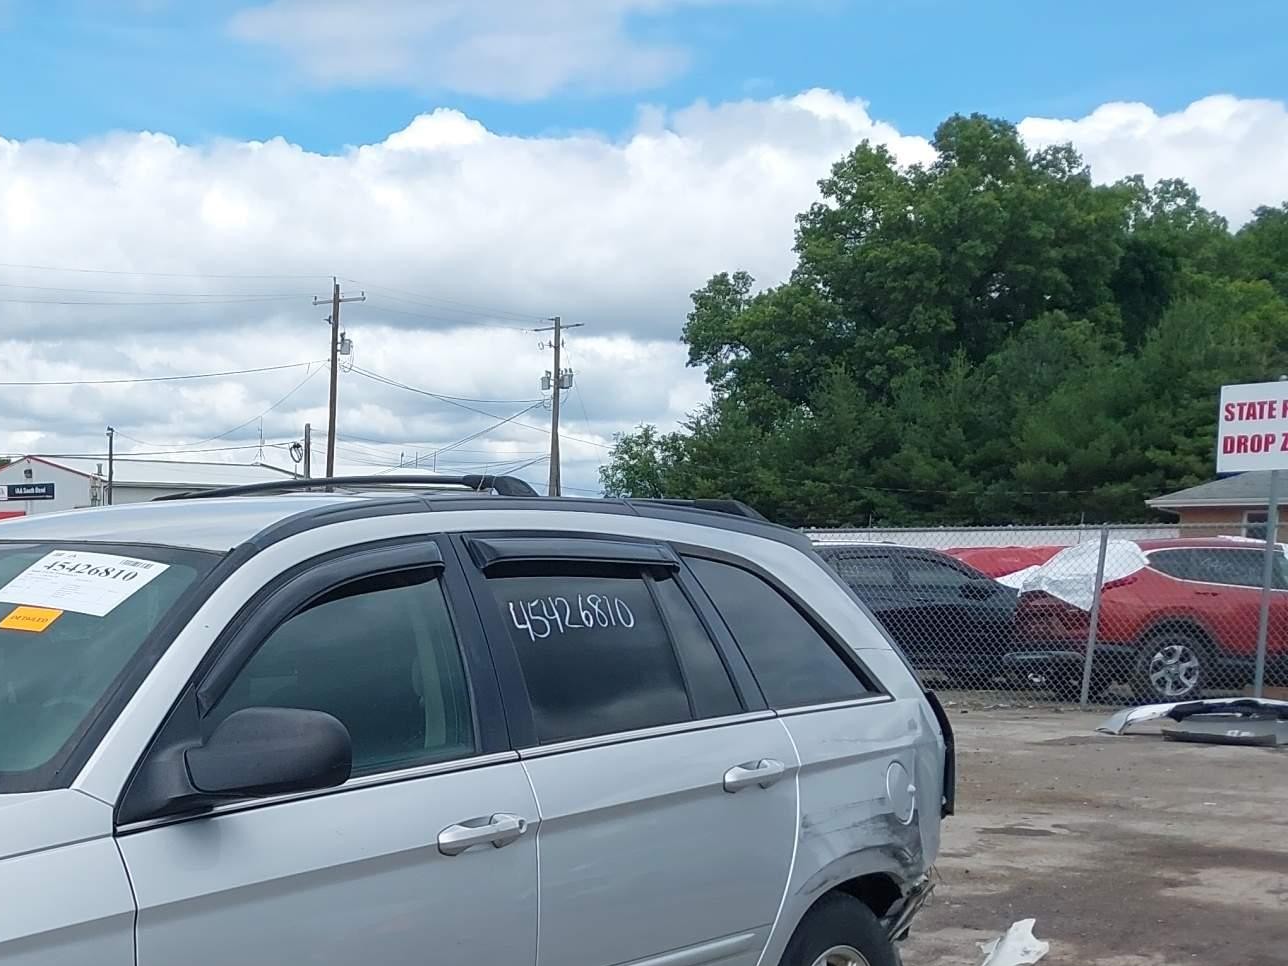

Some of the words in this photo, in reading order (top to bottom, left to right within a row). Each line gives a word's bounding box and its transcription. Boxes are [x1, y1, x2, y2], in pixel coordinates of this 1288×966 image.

[1224, 400, 1277, 421] STATE
[1223, 434, 1276, 454] DROP
[44, 560, 139, 582] 45426810
[509, 594, 635, 642] 45426810
